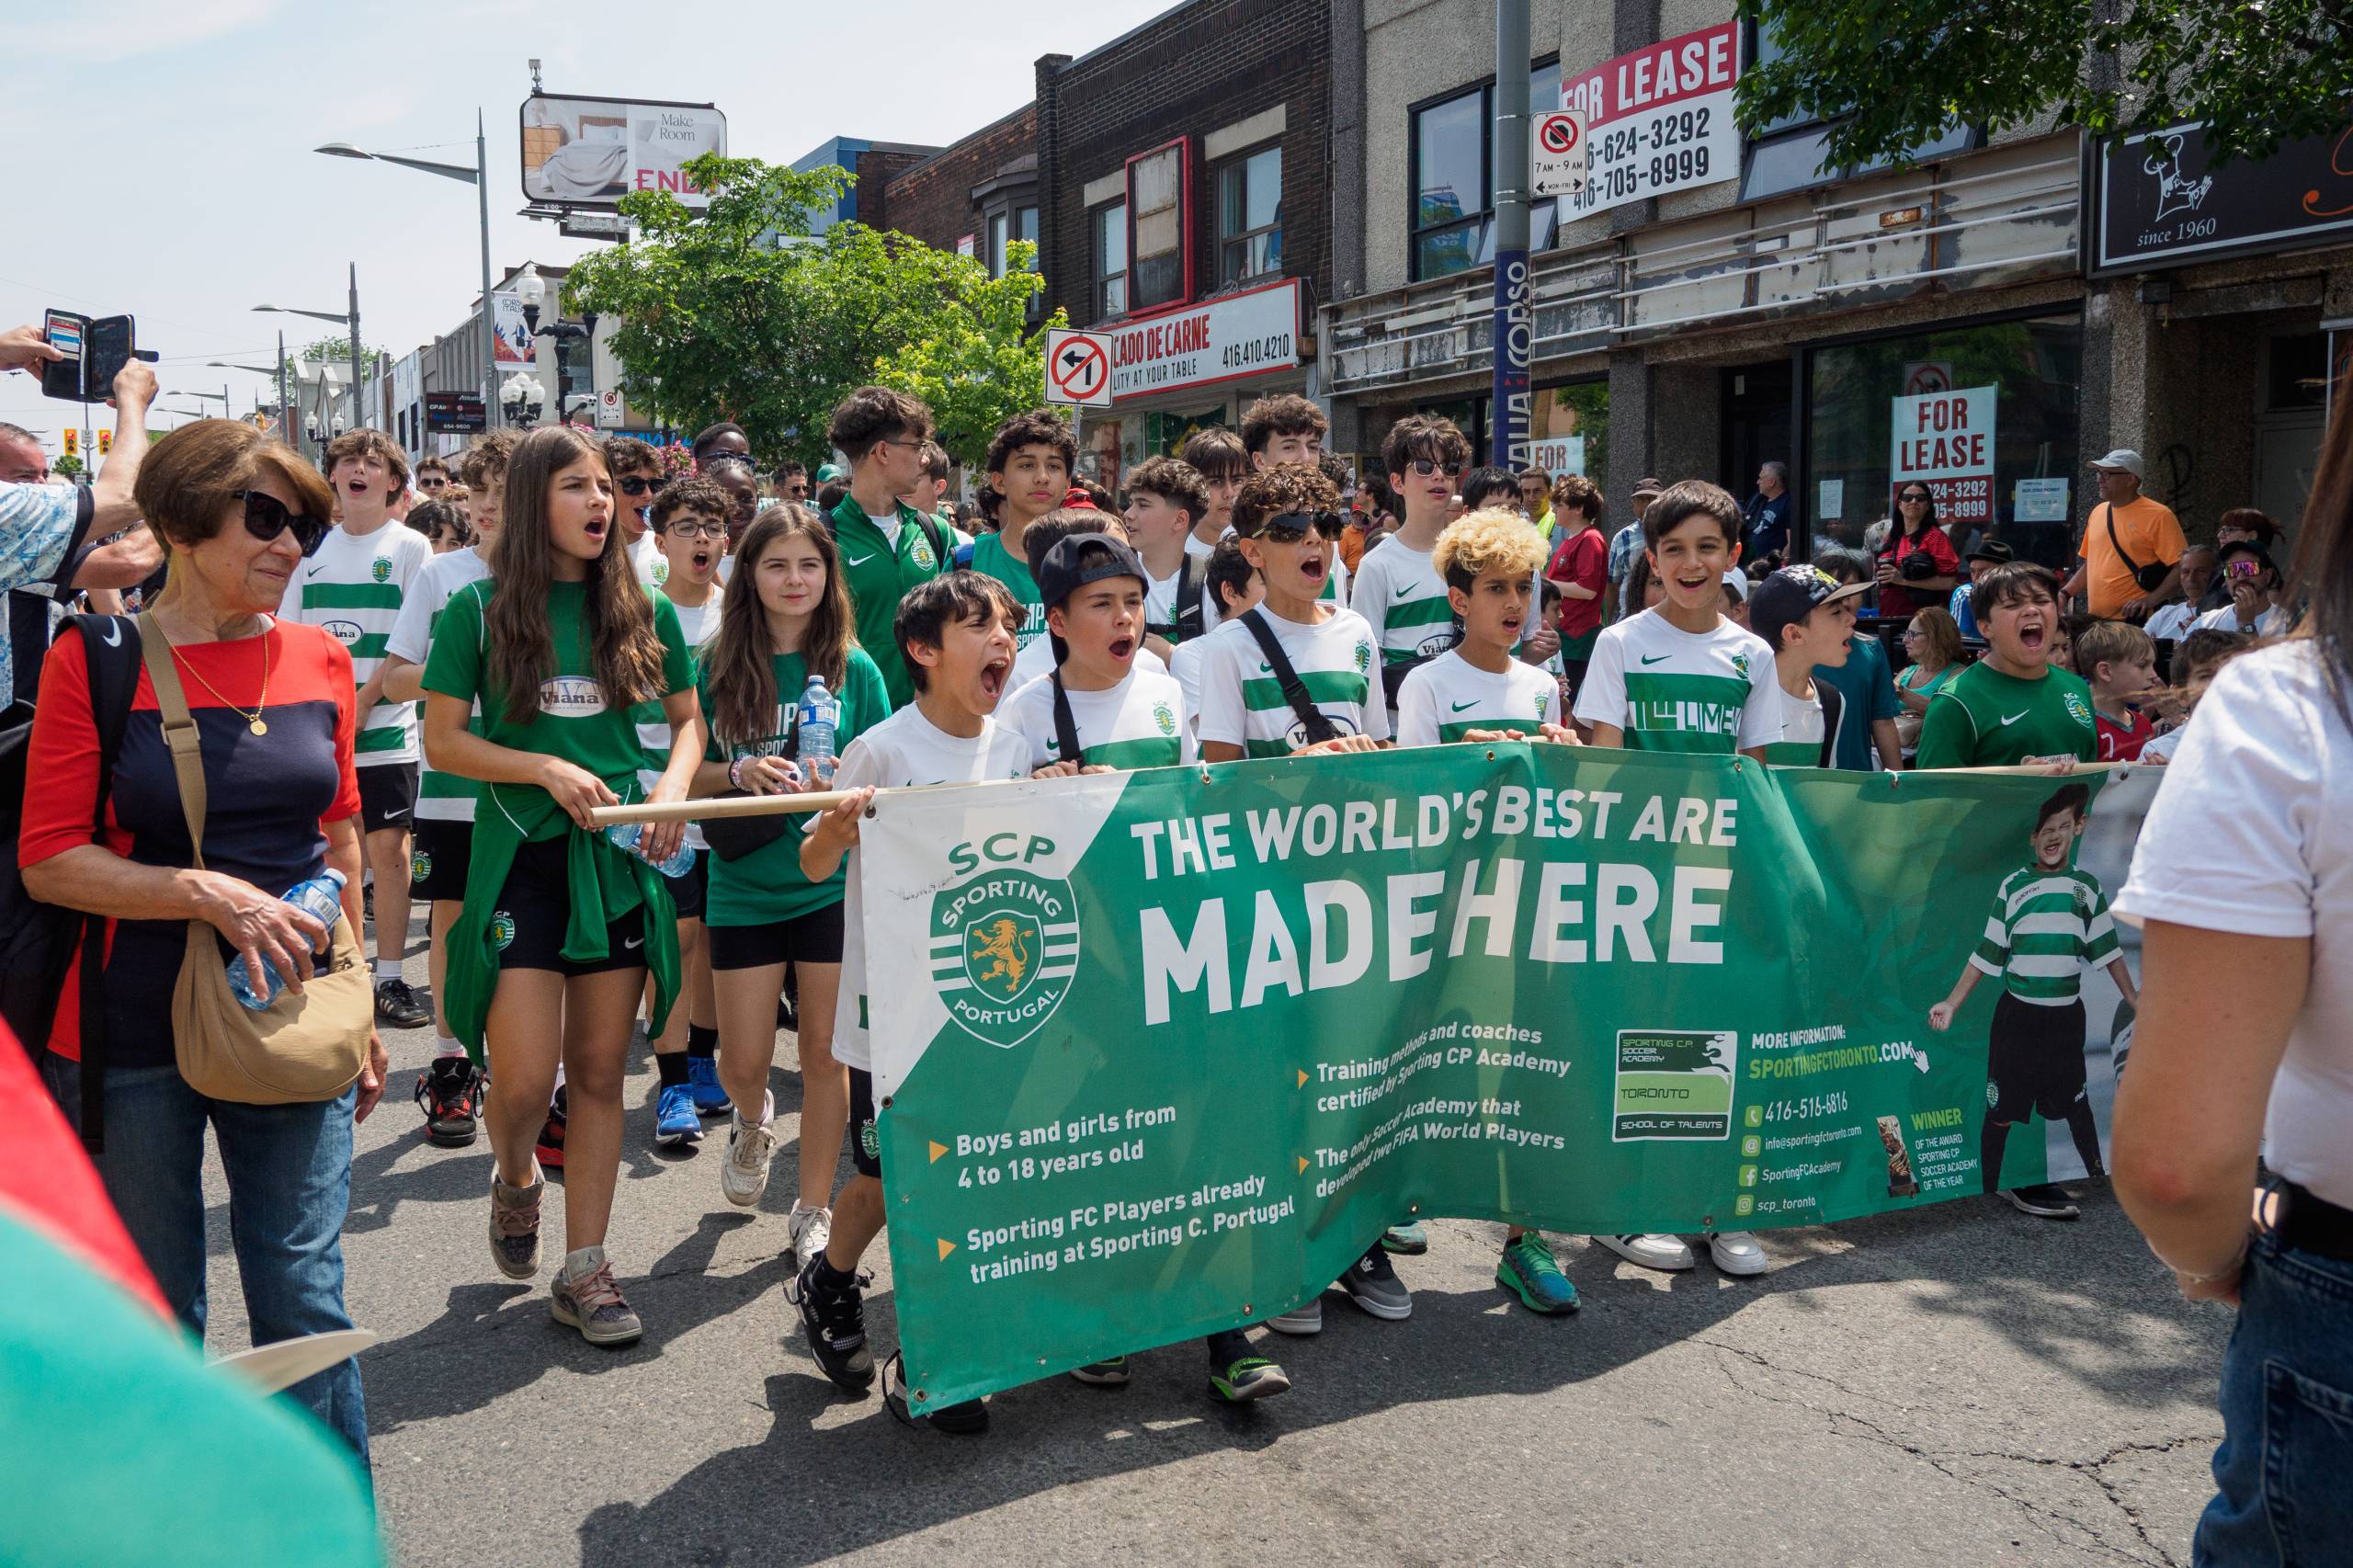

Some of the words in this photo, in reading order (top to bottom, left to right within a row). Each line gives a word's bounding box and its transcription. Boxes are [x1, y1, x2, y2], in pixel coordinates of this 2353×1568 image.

[1563, 75, 1603, 122] FOR
[1618, 34, 1729, 111] LEASE
[660, 127, 696, 142] Room
[662, 113, 693, 128] Make
[1587, 107, 1711, 171] 6-624-3292
[1548, 182, 1571, 190] MON-FRI
[623, 218, 638, 226] astr
[2137, 229, 2172, 247] since
[2176, 217, 2217, 241] 1960
[1507, 261, 1531, 368] CORSO
[1113, 331, 1144, 369] CADO
[1146, 324, 1164, 361] DE
[1165, 313, 1211, 358] CARNE
[1222, 333, 1290, 368] 416.410.4210
[1113, 370, 1131, 391] LITY
[1133, 369, 1142, 387] AT
[1145, 364, 1168, 384] YOUR
[1171, 358, 1197, 379] TABLE
[1917, 397, 1968, 434] FOR
[1535, 444, 1566, 471] FOR
[1901, 433, 1985, 472] LEASE
[540, 690, 599, 704] Viana
[1130, 812, 1236, 881] THE
[1245, 789, 1488, 864] WORLD'S
[1492, 785, 1622, 839] BEST
[1628, 795, 1738, 847] ARE
[948, 832, 1056, 876] SCP
[941, 880, 1063, 928] SPORTING
[1139, 869, 1446, 1027] MADE
[1448, 858, 1733, 964] HERE
[953, 988, 1060, 1025] PORTUGAL
[1316, 1057, 1389, 1083] Training
[1390, 1029, 1427, 1067] methods
[1428, 1021, 1458, 1041] and
[1461, 1023, 1543, 1044] coaches
[1622, 1039, 1674, 1047] SPORTING
[1751, 1032, 1789, 1050] MORE
[1790, 1024, 1847, 1048] INFORMATION:
[1749, 1040, 1914, 1079] SPORTINGFCTORONTO.COM
[1317, 1079, 1386, 1112] certified
[1385, 1073, 1398, 1094] by
[1397, 1050, 1442, 1085] Sporting
[1446, 1047, 1473, 1064] CP
[1475, 1048, 1572, 1078] Academy
[1620, 1088, 1689, 1099] TORONTO
[1765, 1091, 1848, 1122] 416-516-6816
[1911, 1108, 1963, 1131] WINNER
[956, 1132, 1013, 1157] Boys
[1018, 1121, 1061, 1146] and
[1066, 1112, 1120, 1143] girls
[1125, 1104, 1176, 1131] from
[1314, 1147, 1348, 1168] The
[1349, 1131, 1372, 1159] only
[1371, 1112, 1404, 1143] Soccer
[1404, 1096, 1478, 1119] Academy
[1482, 1098, 1521, 1117] that
[1620, 1120, 1657, 1130] SCHOOL
[1660, 1120, 1675, 1129] OF
[1677, 1120, 1723, 1129] TALENTS
[1765, 1126, 1862, 1151] info@sportingfctoronto.com
[1915, 1139, 1925, 1150] OF
[1926, 1136, 1938, 1147] THE
[1938, 1133, 1963, 1145] AWARD
[958, 1166, 972, 1188] 4
[977, 1164, 1001, 1187] to
[1007, 1157, 1035, 1181] 18
[1040, 1147, 1104, 1179] years
[1109, 1139, 1144, 1163] old
[1315, 1153, 1371, 1199] developed
[1372, 1143, 1392, 1162] two
[1392, 1124, 1418, 1151] FIFA
[1423, 1122, 1481, 1141] World
[1485, 1123, 1565, 1150] Players
[1762, 1160, 1842, 1183] SportingFCAcademy
[1917, 1150, 1950, 1164] SPORTING
[1950, 1148, 1961, 1158] CP
[1920, 1164, 1947, 1177] SOCCER
[1947, 1158, 1978, 1173] ACADEMY
[1923, 1180, 1933, 1190] OF
[1933, 1177, 1947, 1188] THE
[1947, 1175, 1964, 1187] YEAR
[966, 1212, 1064, 1252] Sporting
[1070, 1206, 1098, 1231] FC
[1103, 1190, 1186, 1224] Players
[1191, 1173, 1266, 1206] already
[1756, 1196, 1816, 1211] scp_toronto
[970, 1247, 1058, 1284] training
[1063, 1241, 1086, 1264] at
[1089, 1222, 1182, 1259] Sporting
[1188, 1216, 1208, 1237] C.
[1213, 1195, 1296, 1233] Portugal
